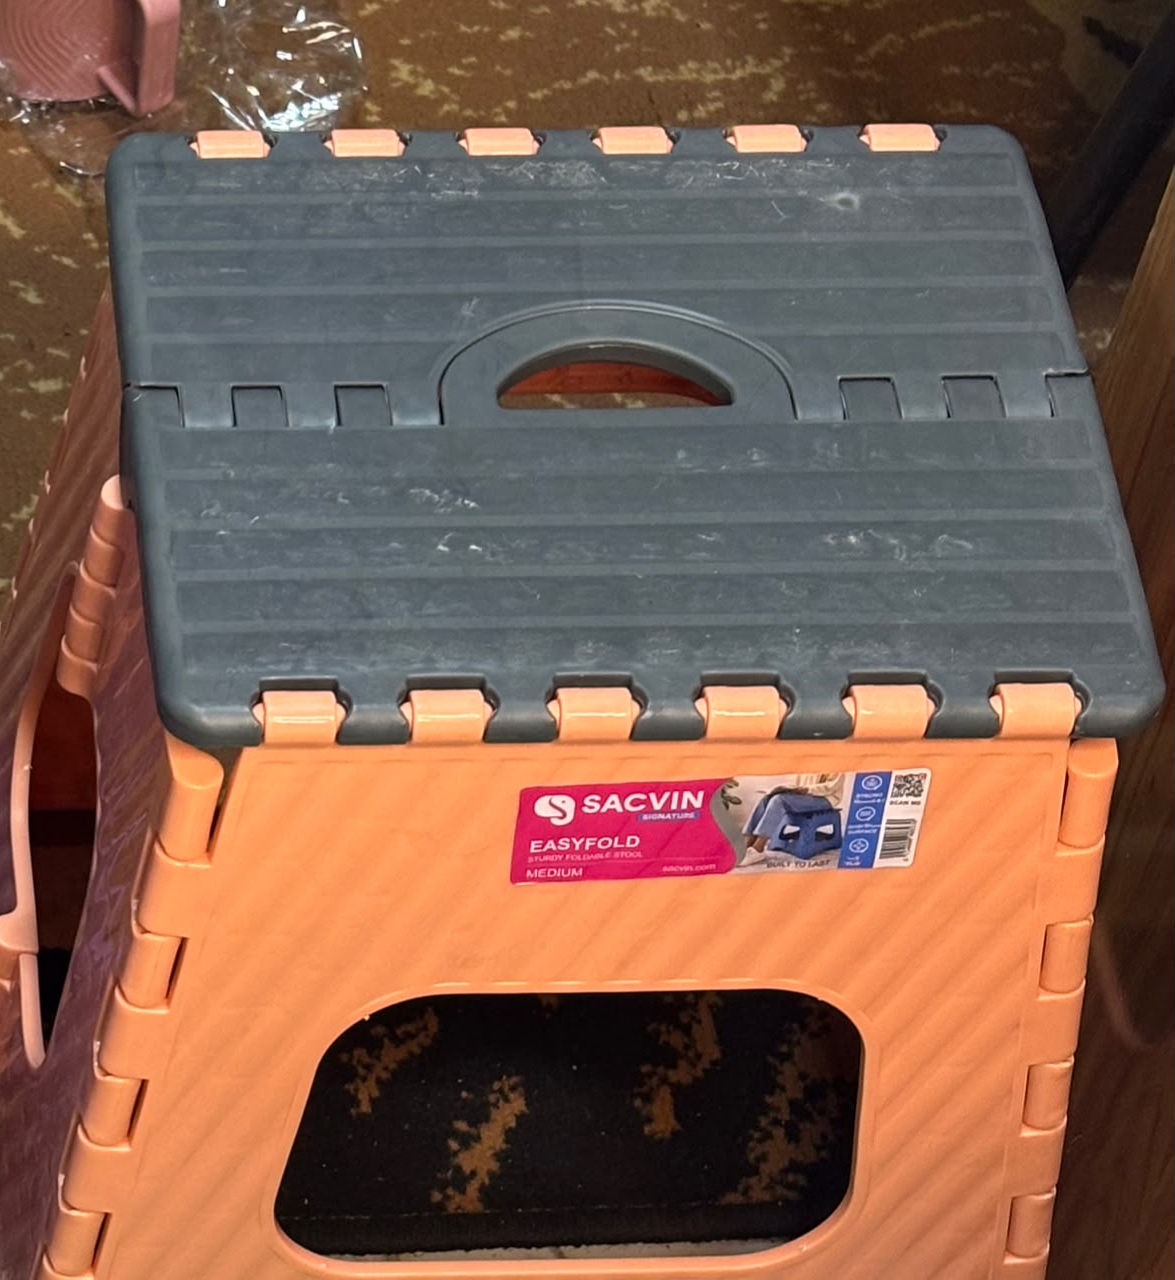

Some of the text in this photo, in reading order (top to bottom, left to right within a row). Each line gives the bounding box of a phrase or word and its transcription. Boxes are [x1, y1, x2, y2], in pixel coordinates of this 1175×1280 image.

[581, 790, 705, 813] SACVIN
[642, 811, 695, 820] SIGNATURE
[529, 835, 641, 853] EASYFOLD
[527, 851, 643, 863] STURDY FOLDABLE STOOL
[662, 863, 716, 873] sacvin.com
[766, 861, 791, 869] BUILT
[808, 859, 830, 868] LAST
[526, 867, 583, 879] MEDIUM
